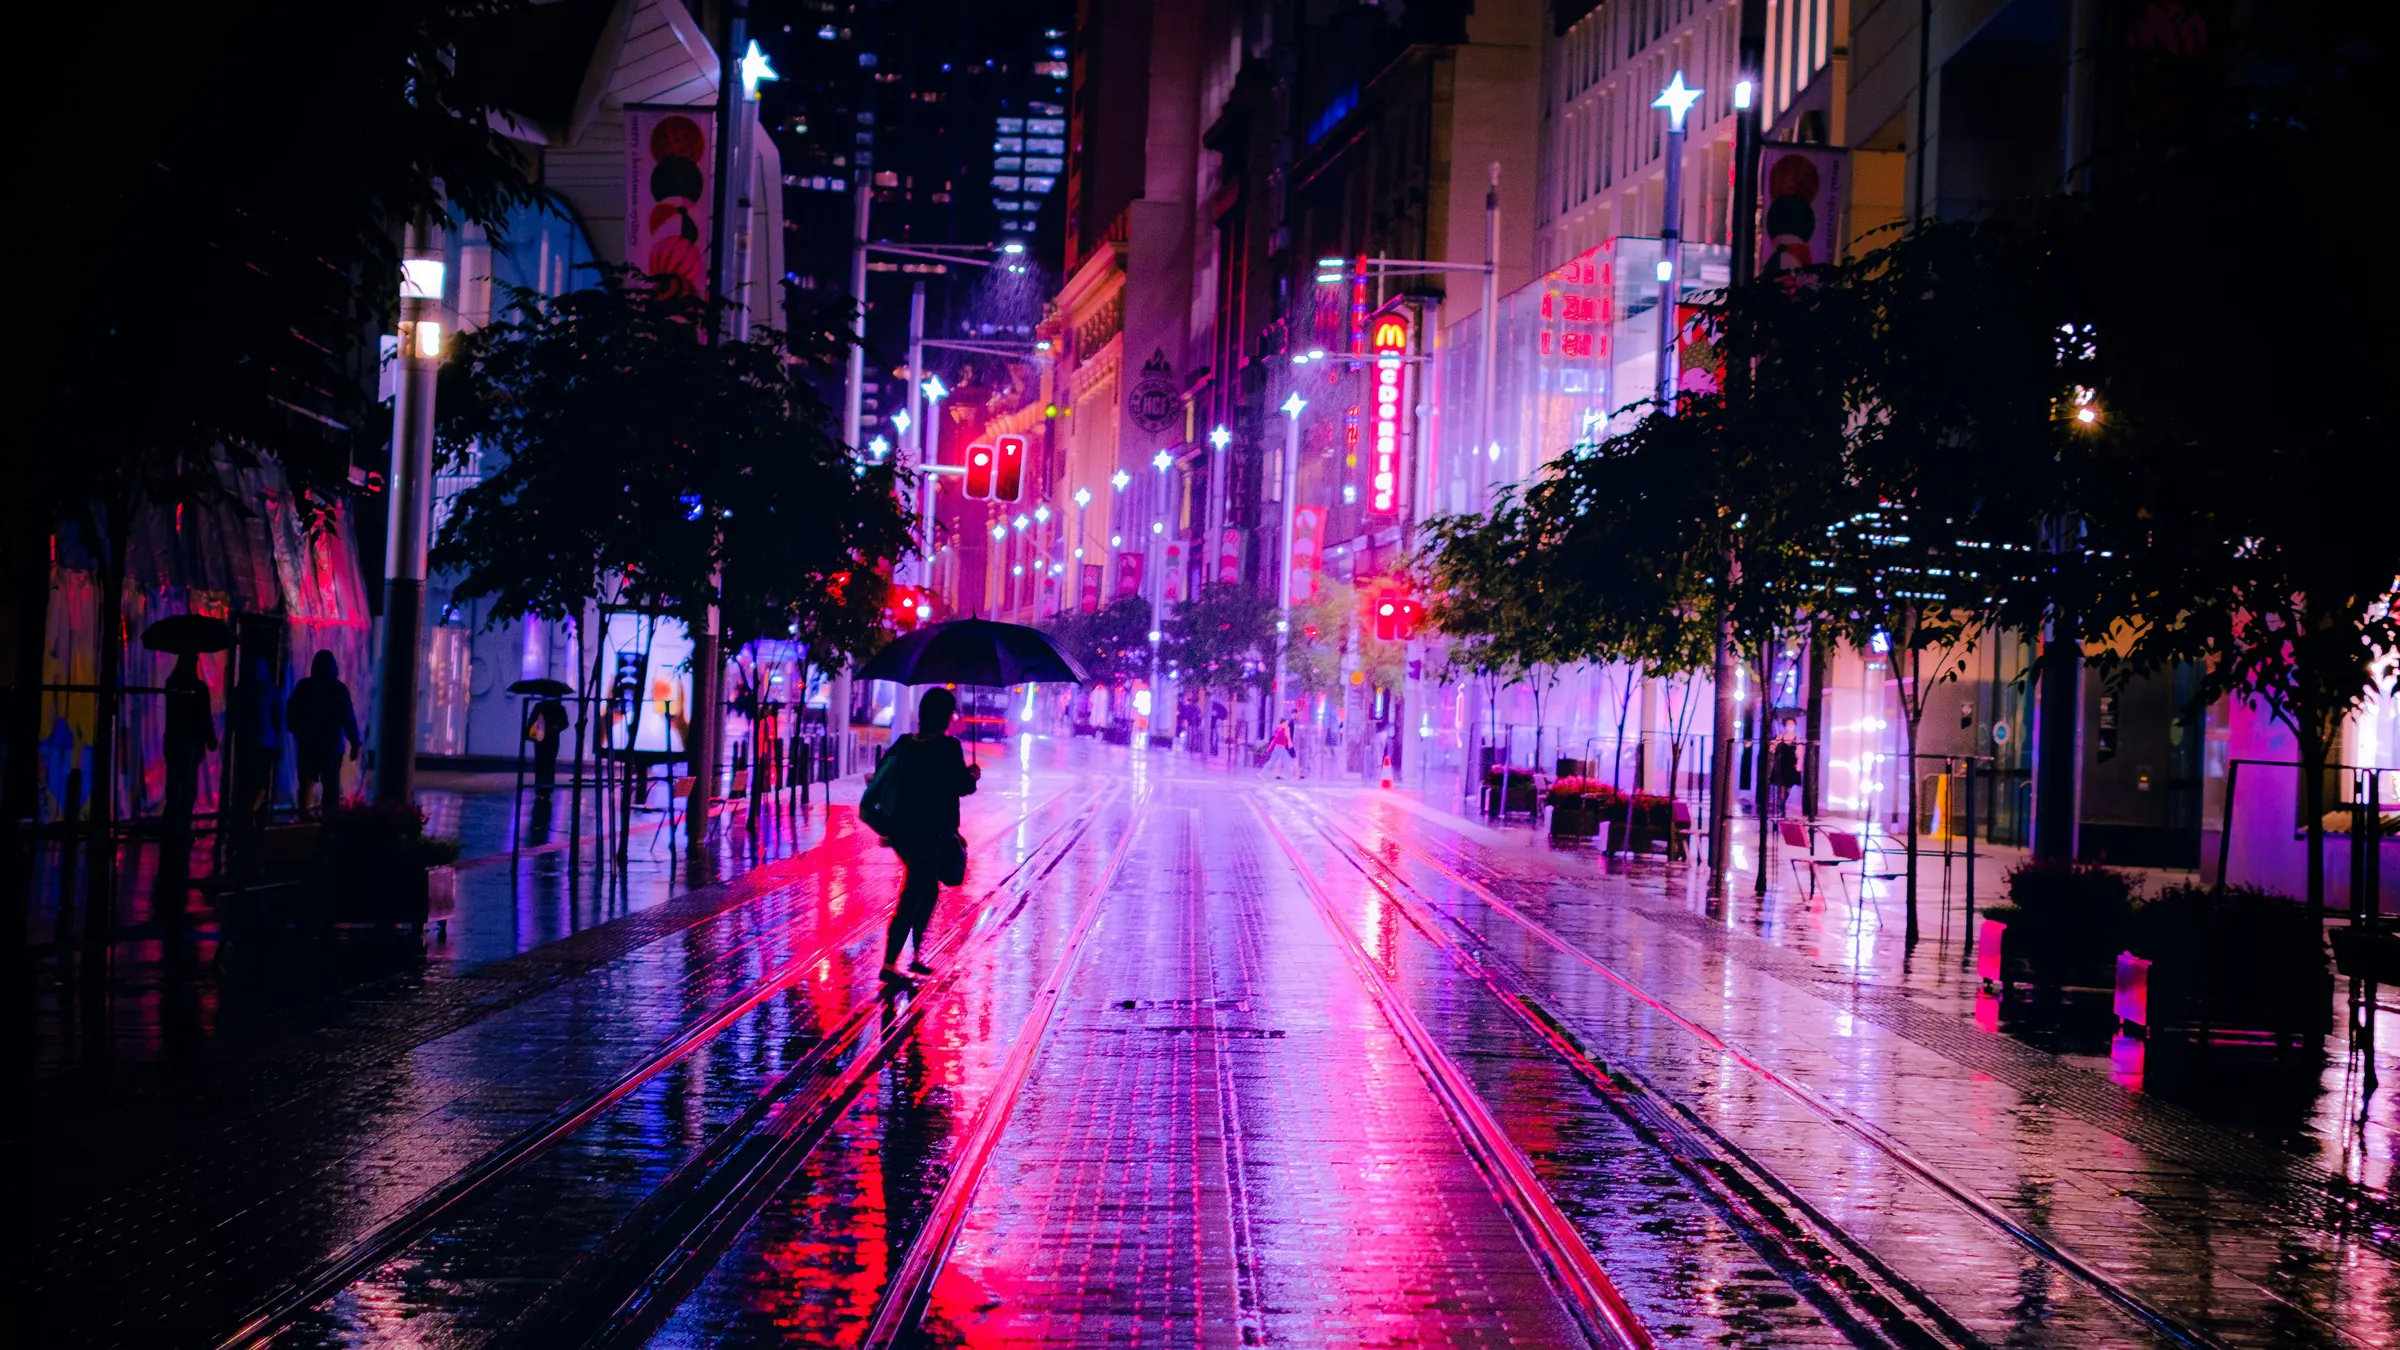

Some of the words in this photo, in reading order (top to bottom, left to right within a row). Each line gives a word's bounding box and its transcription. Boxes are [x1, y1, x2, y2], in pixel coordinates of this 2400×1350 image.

[631, 115, 639, 148] merry
[631, 150, 641, 205] christmas
[629, 208, 641, 247] sydney
